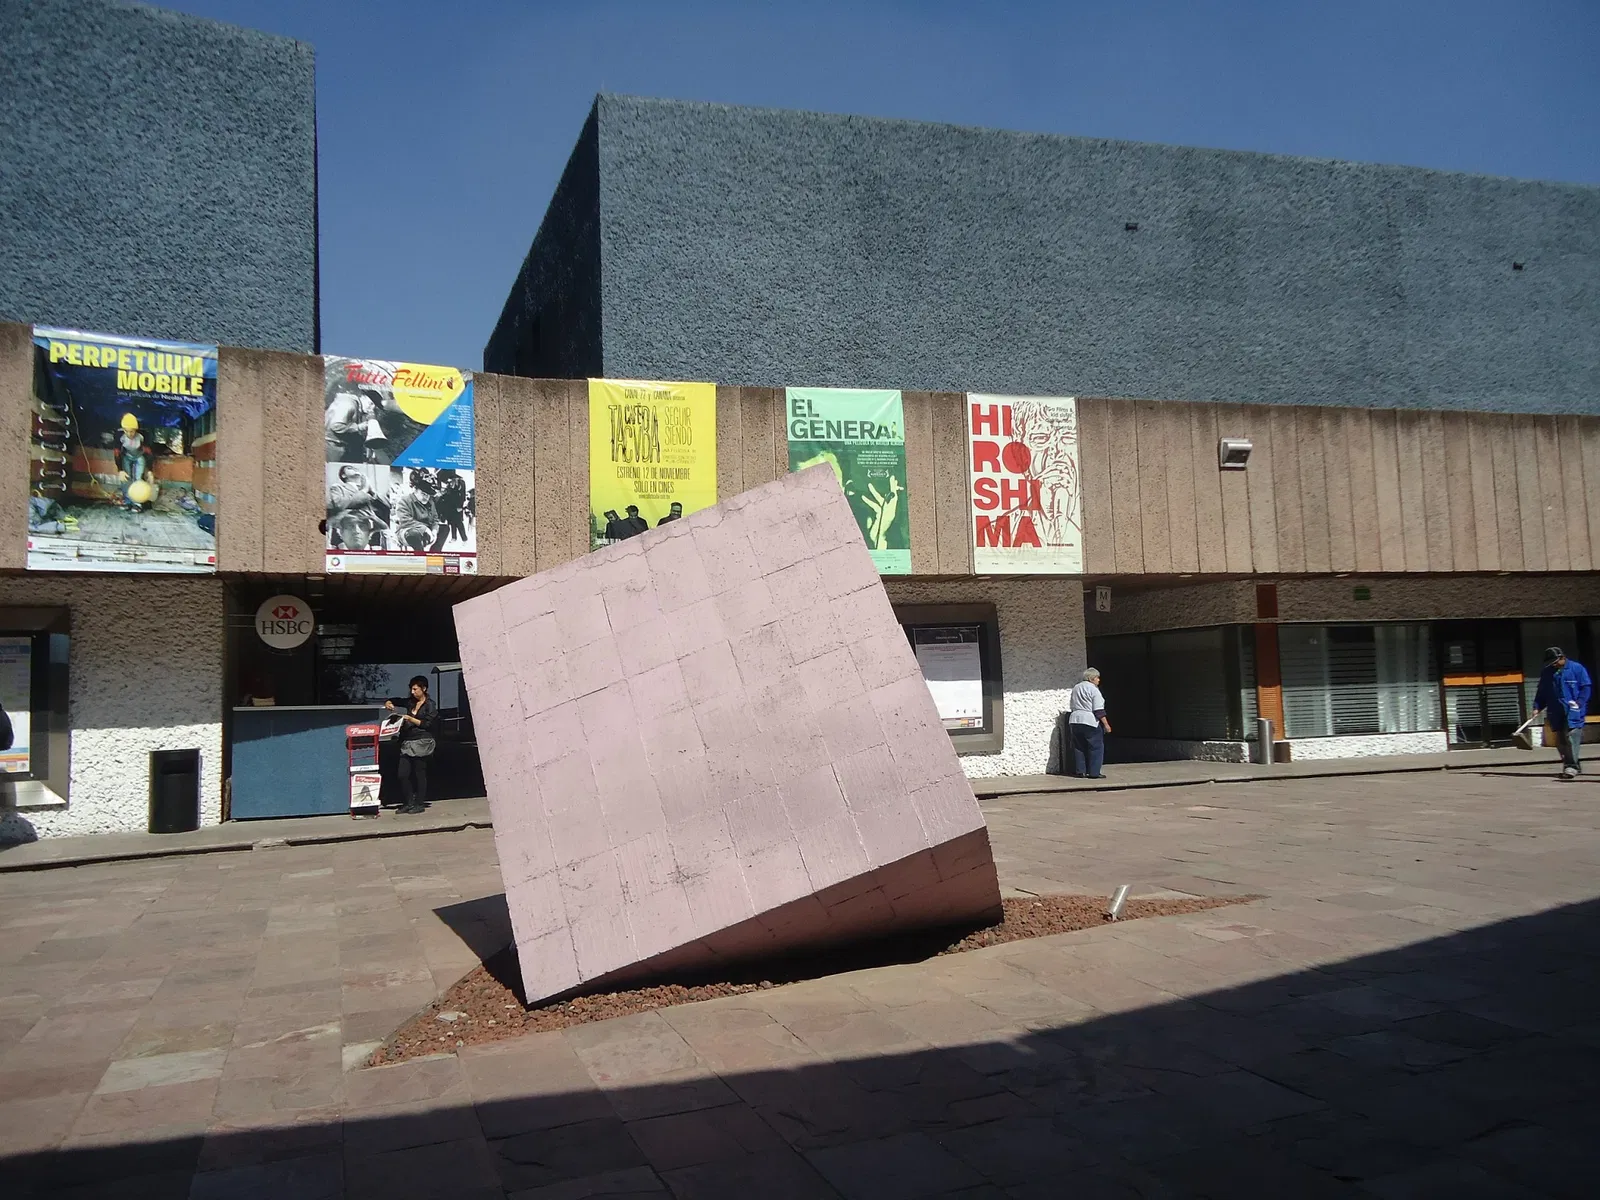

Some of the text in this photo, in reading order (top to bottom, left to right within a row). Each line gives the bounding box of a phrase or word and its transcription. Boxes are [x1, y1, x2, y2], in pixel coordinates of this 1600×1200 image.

[49, 341, 204, 377] PERPETUUM
[116, 370, 203, 396] MOBILE
[344, 363, 387, 386] Tutto
[391, 369, 445, 391] Fellini
[664, 406, 692, 427] SEGUIR
[791, 398, 820, 418] EL
[971, 403, 1013, 437] HI
[608, 404, 661, 464] TACVBA
[664, 426, 693, 446] SIENDO
[972, 440, 1032, 474] RO
[616, 466, 691, 481] ESTRENO 12 DE NOVIEMBRE
[649, 481, 657, 493] EN
[658, 481, 675, 494] CINES
[973, 477, 1042, 511] SHI
[975, 515, 1042, 548] MA
[1099, 591, 1108, 600] M
[261, 620, 310, 635] HSBC
